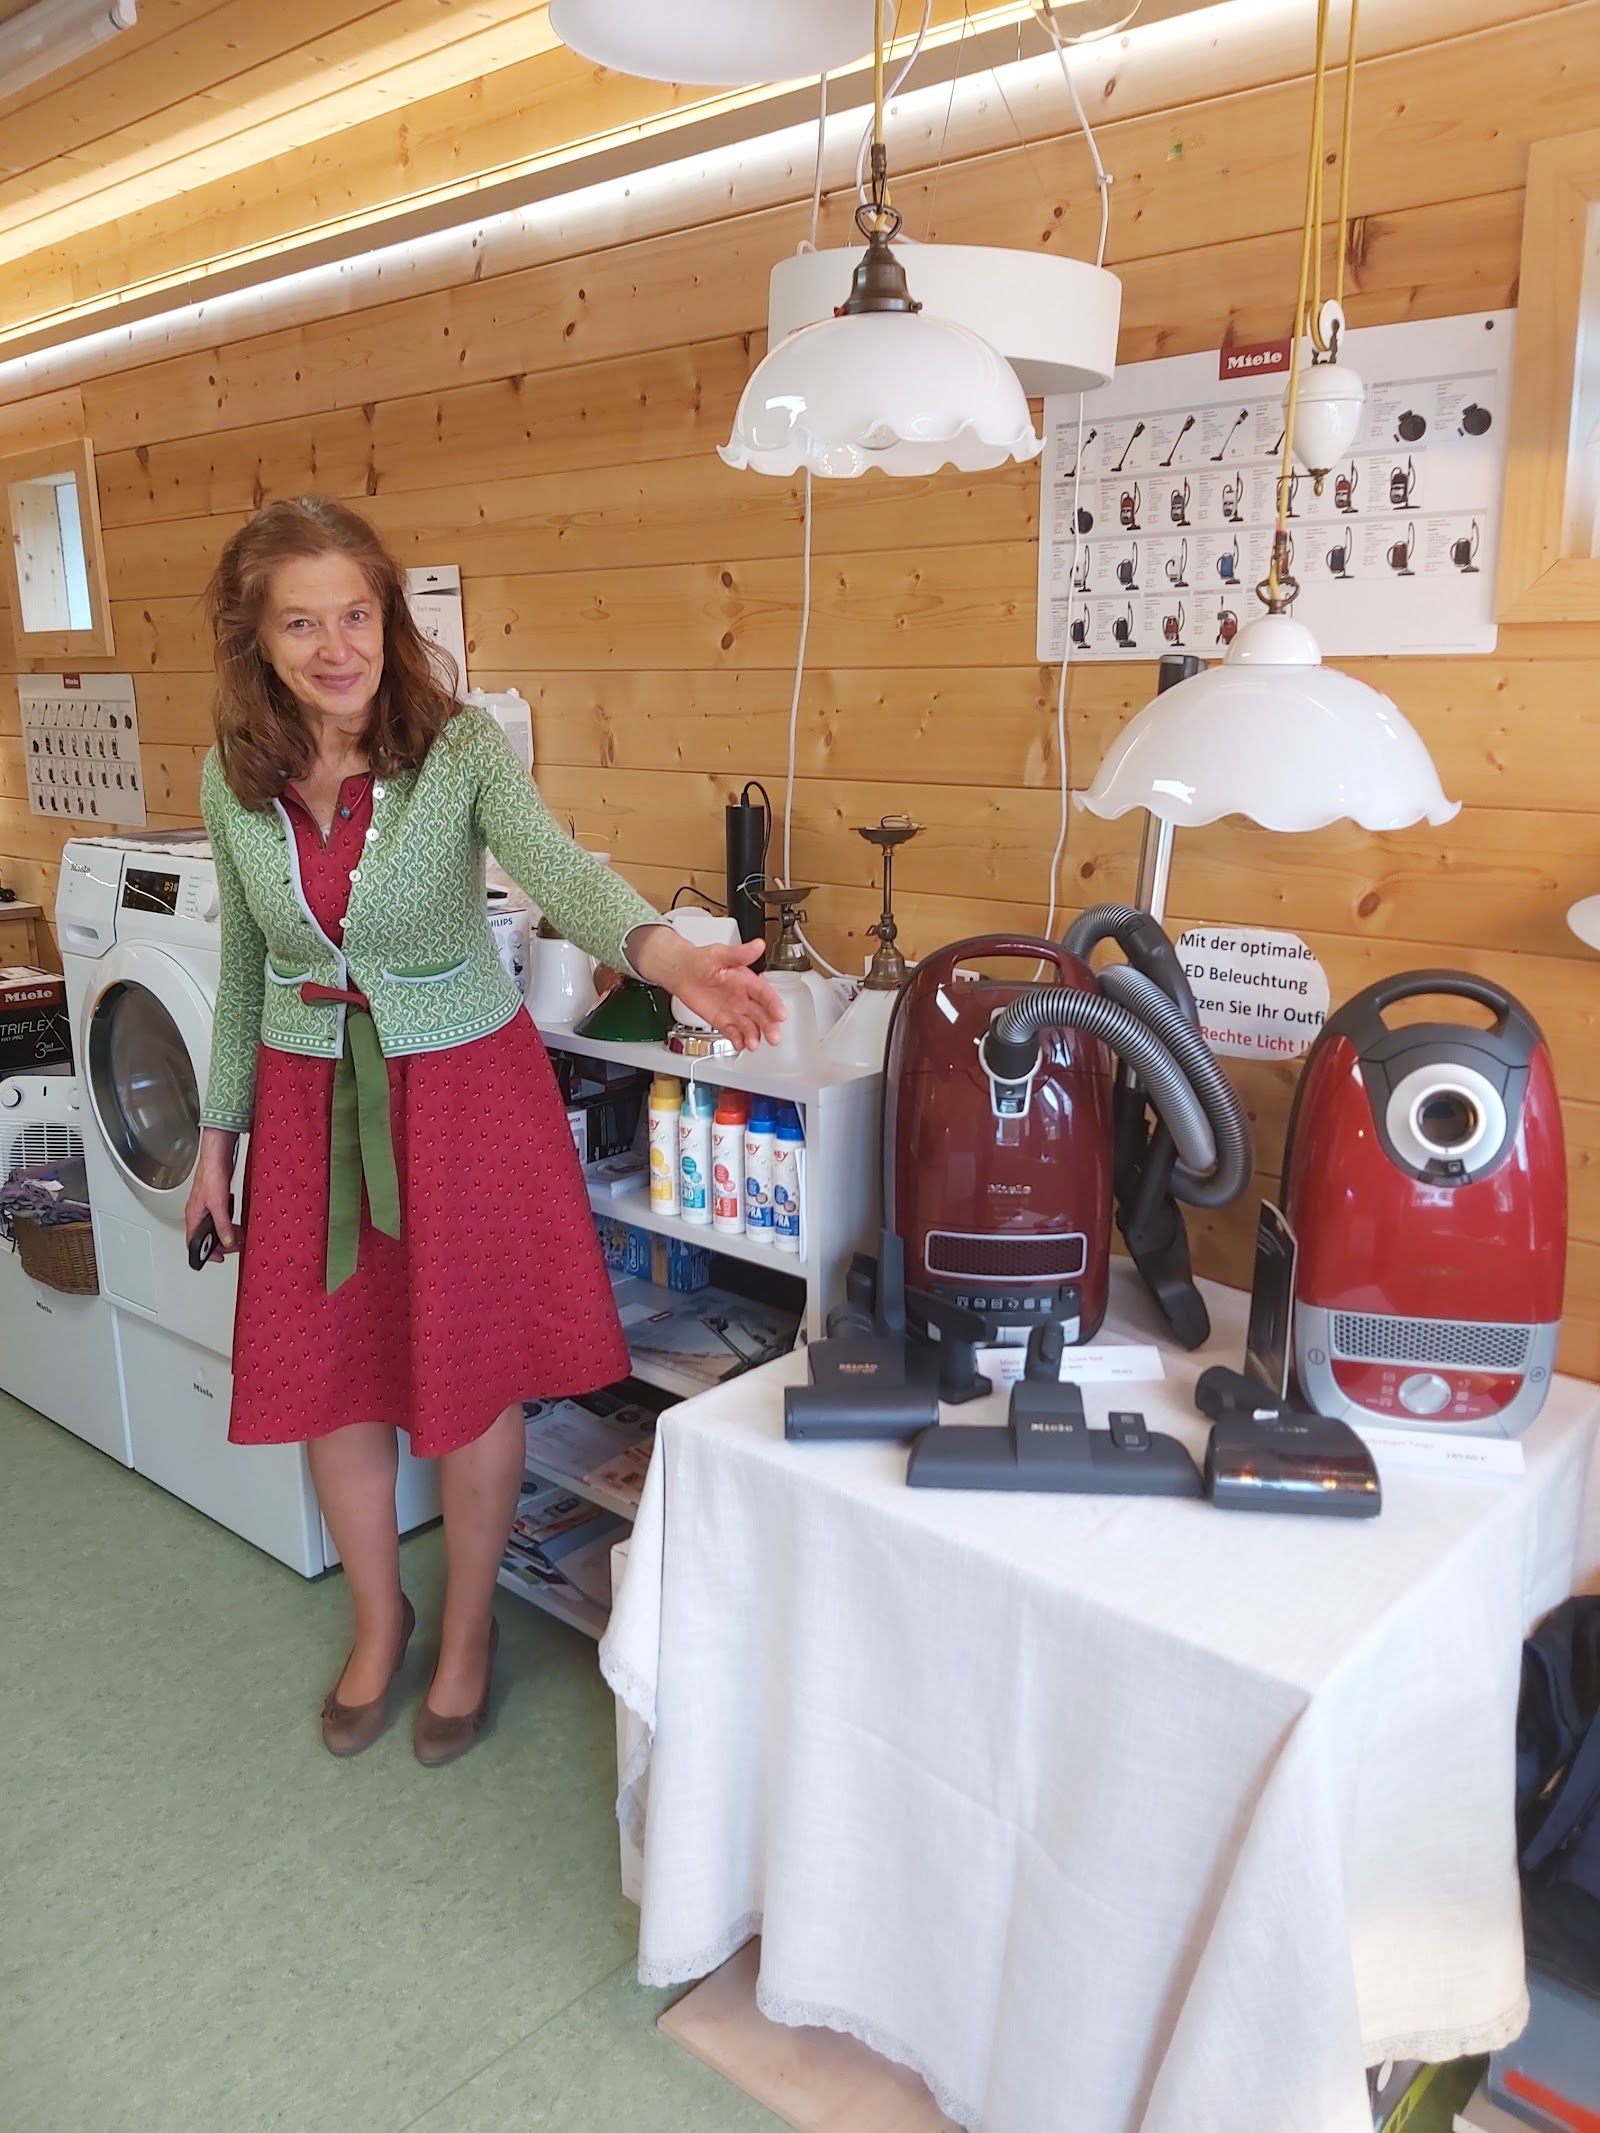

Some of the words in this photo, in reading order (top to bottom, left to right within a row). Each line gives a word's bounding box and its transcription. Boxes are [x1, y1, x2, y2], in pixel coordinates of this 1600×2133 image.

[1226, 350, 1283, 370] Miele
[490, 917, 513, 928] HILIPS
[1180, 933, 1206, 948] Mit
[1210, 936, 1236, 951] der
[1184, 963, 1204, 978] ED
[1209, 967, 1308, 995] Beleuchtung
[3, 989, 53, 1003] Miele
[1229, 1000, 1252, 1016] Sie
[1257, 1003, 1279, 1019] Ihr
[1284, 1007, 1325, 1026] Outfi
[0, 1018, 55, 1036] TRIFLEX
[1199, 1025, 1252, 1045] Rechte
[1257, 1034, 1294, 1053] Licht
[193, 1382, 214, 1399] Miele
[1030, 1421, 1073, 1433] Miele
